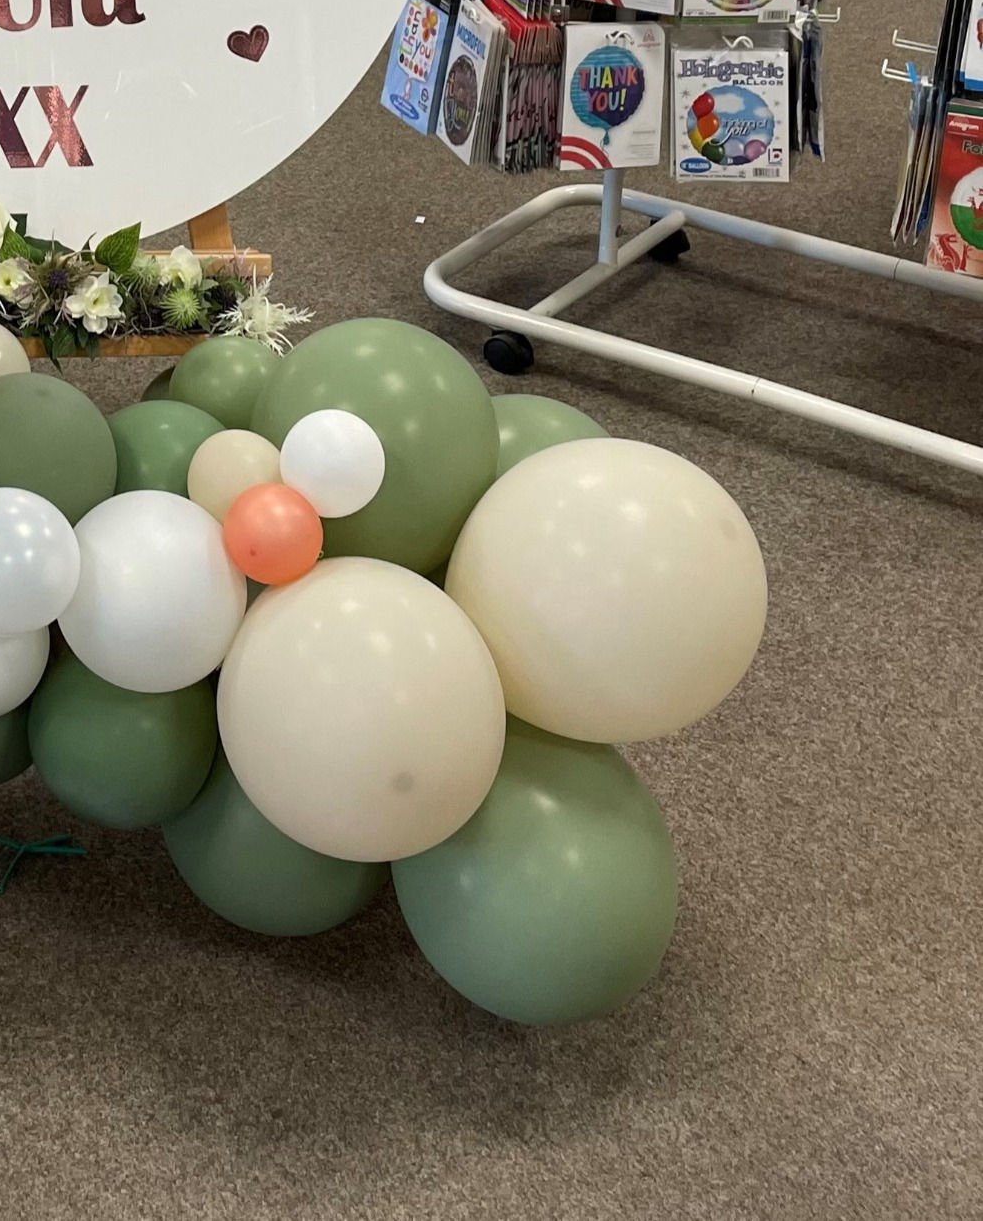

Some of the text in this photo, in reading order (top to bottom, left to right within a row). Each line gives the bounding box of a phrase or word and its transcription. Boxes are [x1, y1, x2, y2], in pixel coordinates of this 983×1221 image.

[579, 64, 639, 92] THANK
[678, 58, 785, 82] Holographic
[586, 86, 627, 112] YOU!
